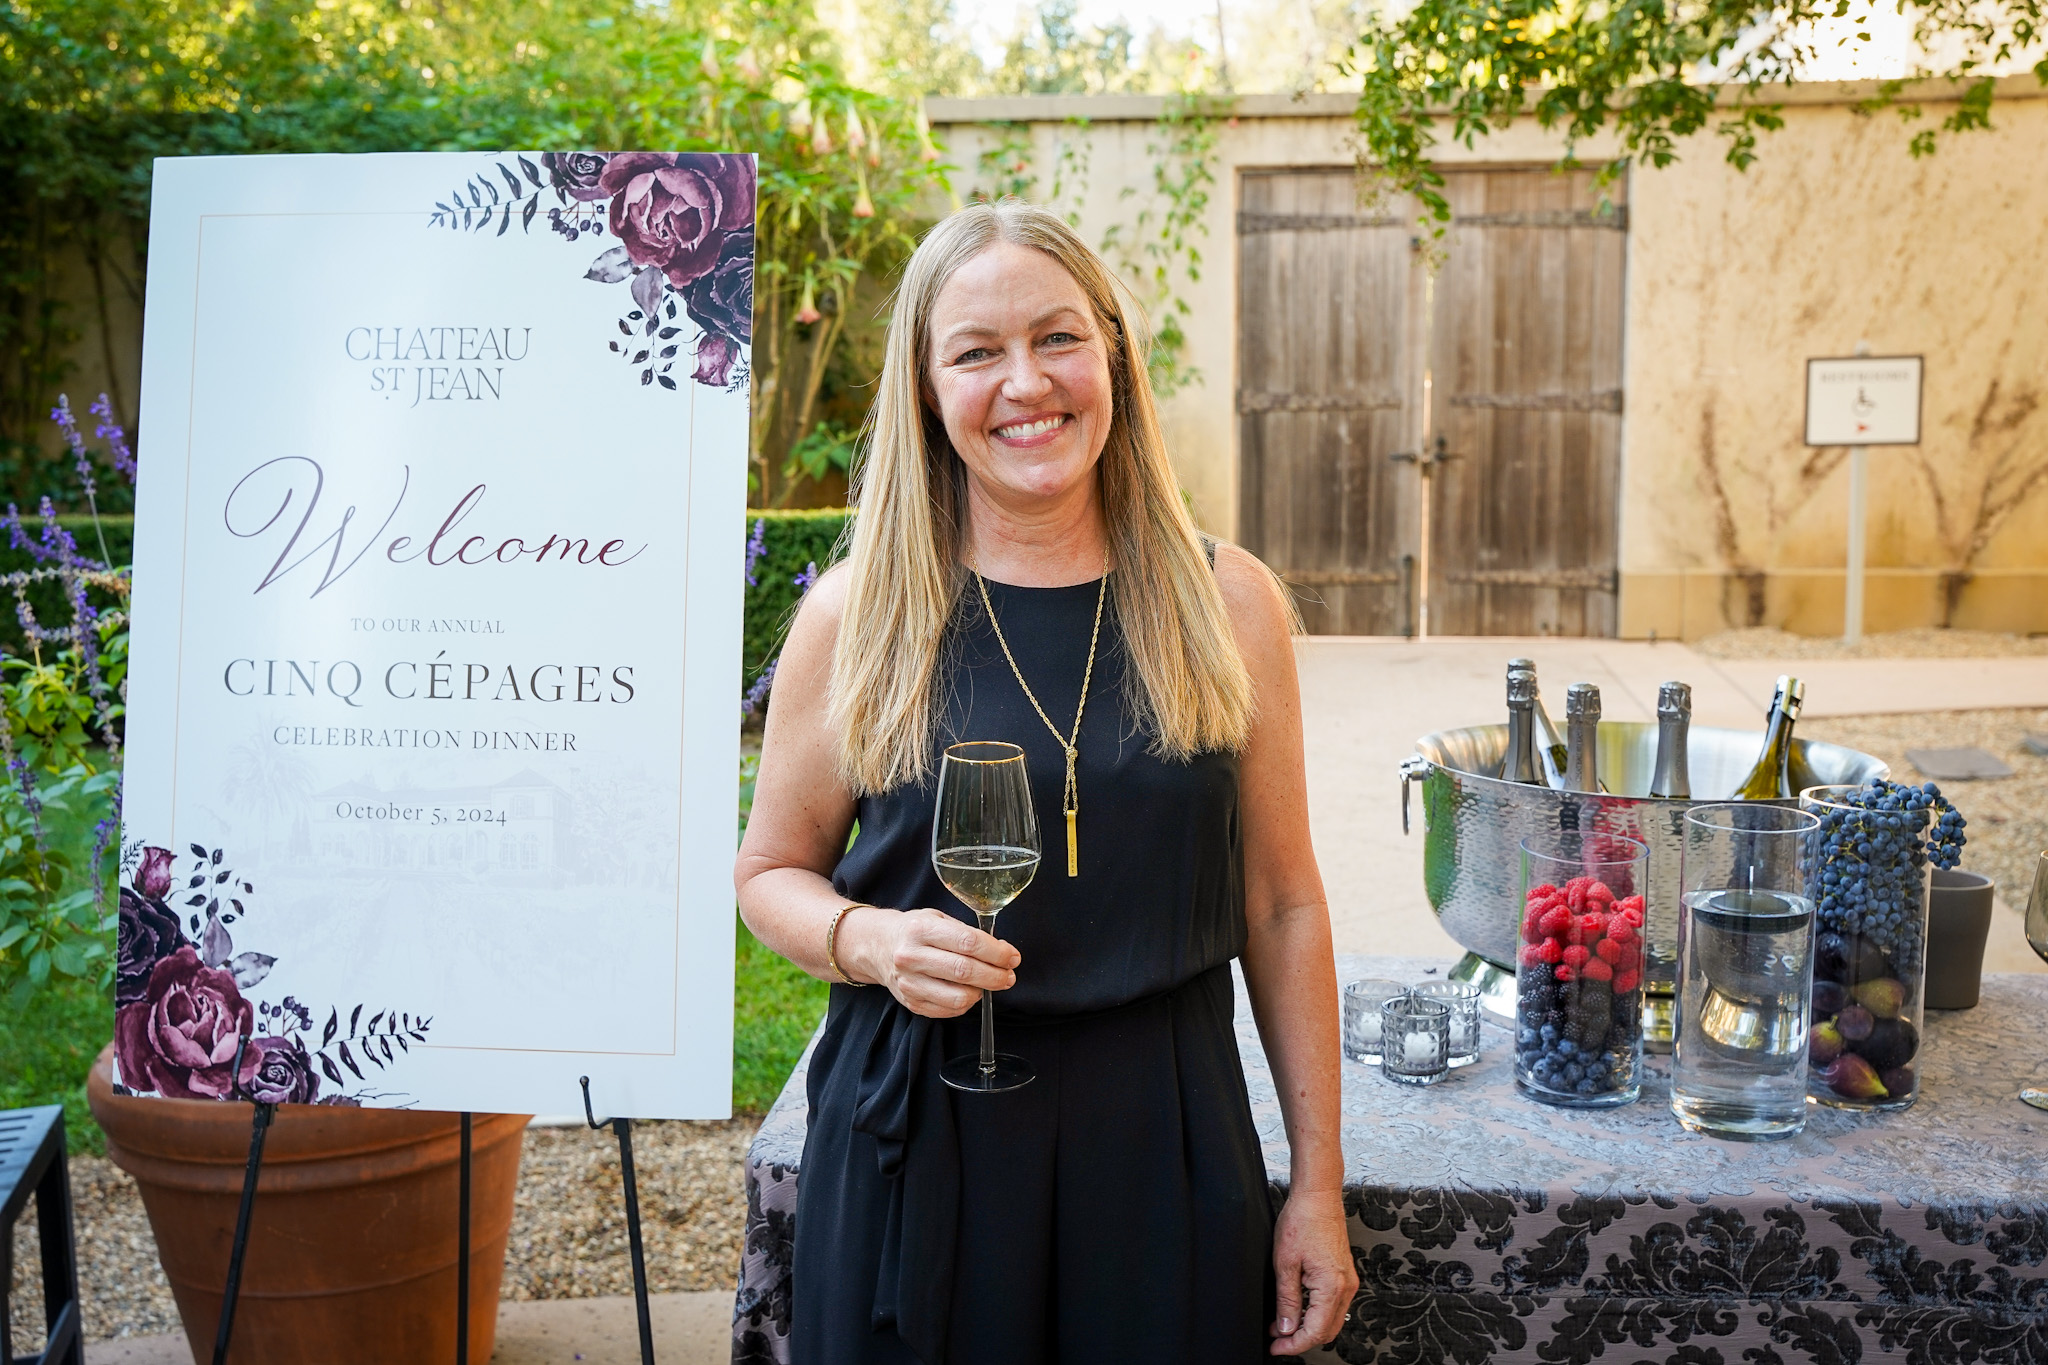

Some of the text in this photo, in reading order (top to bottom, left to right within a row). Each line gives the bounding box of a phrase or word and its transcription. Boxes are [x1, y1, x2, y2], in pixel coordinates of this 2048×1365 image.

[345, 326, 533, 361] CHATEAU
[410, 366, 504, 409] JEAN
[223, 455, 649, 600] Welcome
[350, 617, 505, 634] TO OUR ANNUAL
[223, 649, 635, 708] CINQ CÉPAGES
[273, 725, 579, 752] CELEBRATION DINNER
[335, 800, 508, 826] October 5, 2024
